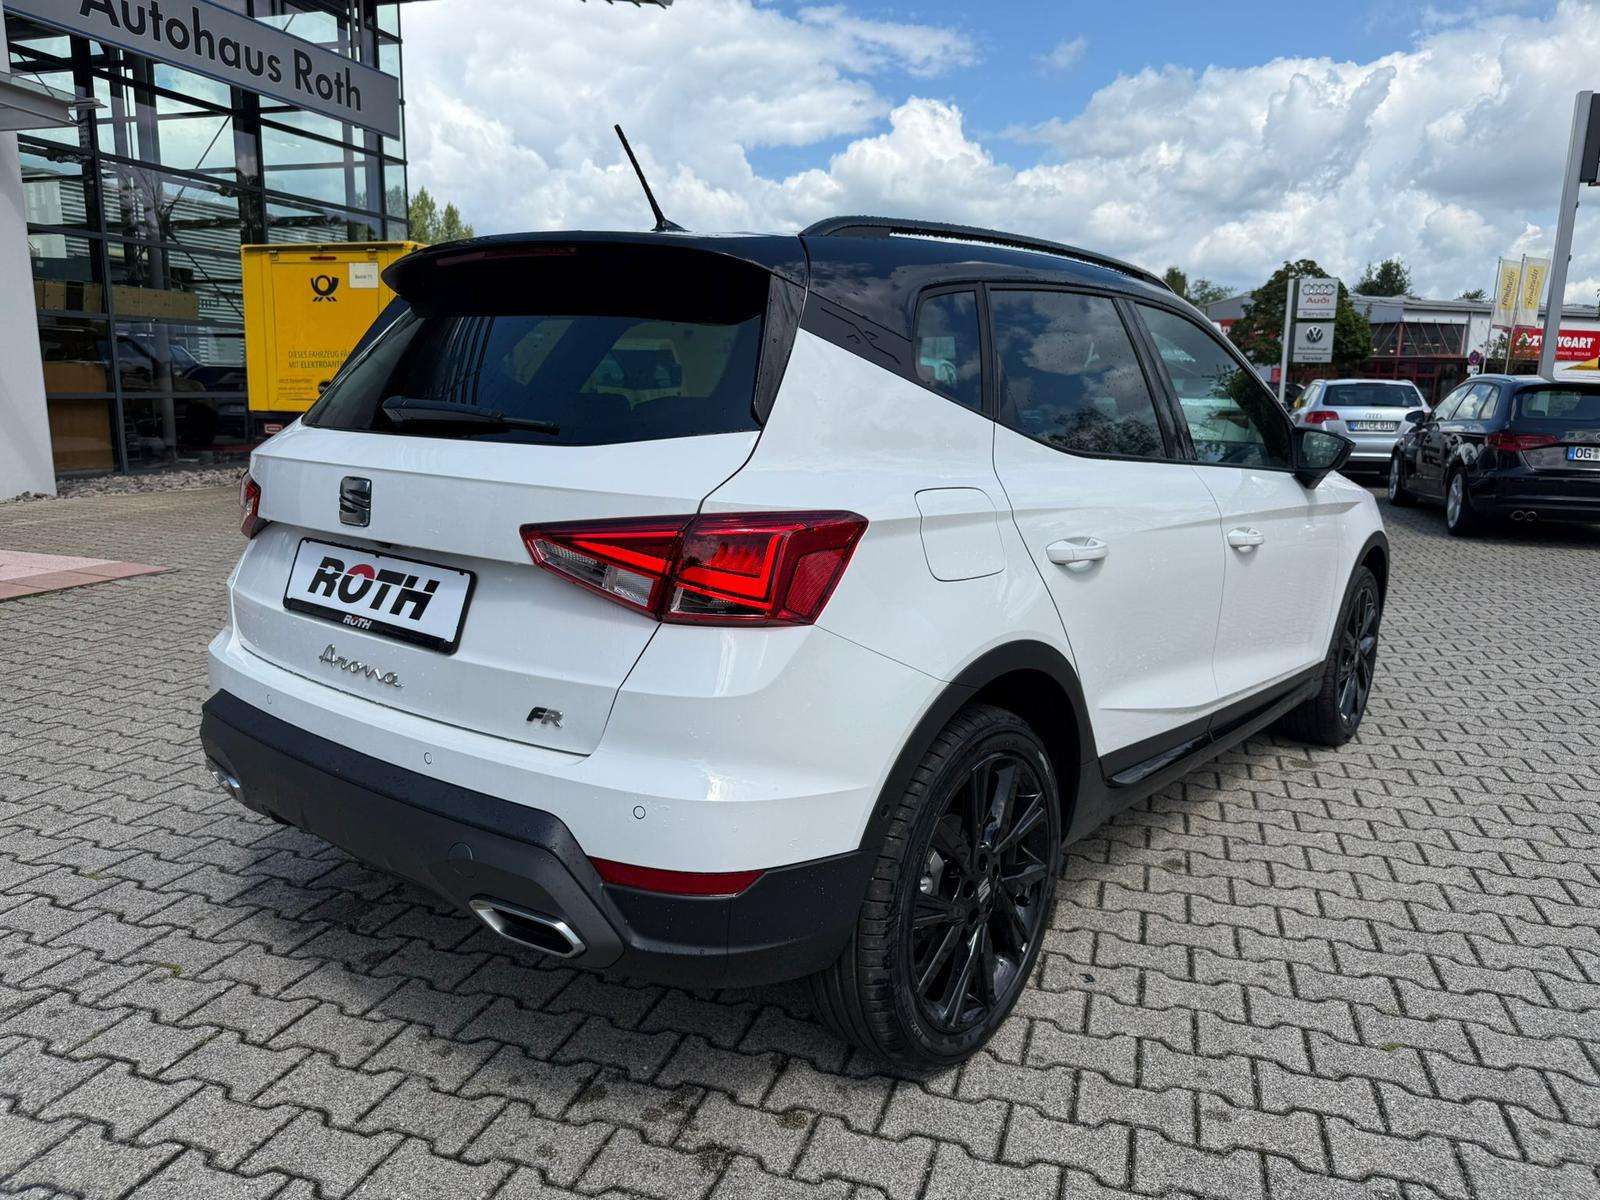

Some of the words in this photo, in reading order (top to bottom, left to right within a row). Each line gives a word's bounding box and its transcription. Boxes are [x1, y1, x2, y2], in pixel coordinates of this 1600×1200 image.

[294, 48, 362, 111] Roth
[1531, 334, 1593, 348] ZYGART
[1576, 448, 1592, 458] OG
[307, 556, 440, 621] ROTH
[343, 614, 372, 630] ROTH
[318, 643, 405, 689] Arona
[526, 706, 564, 729] FR
